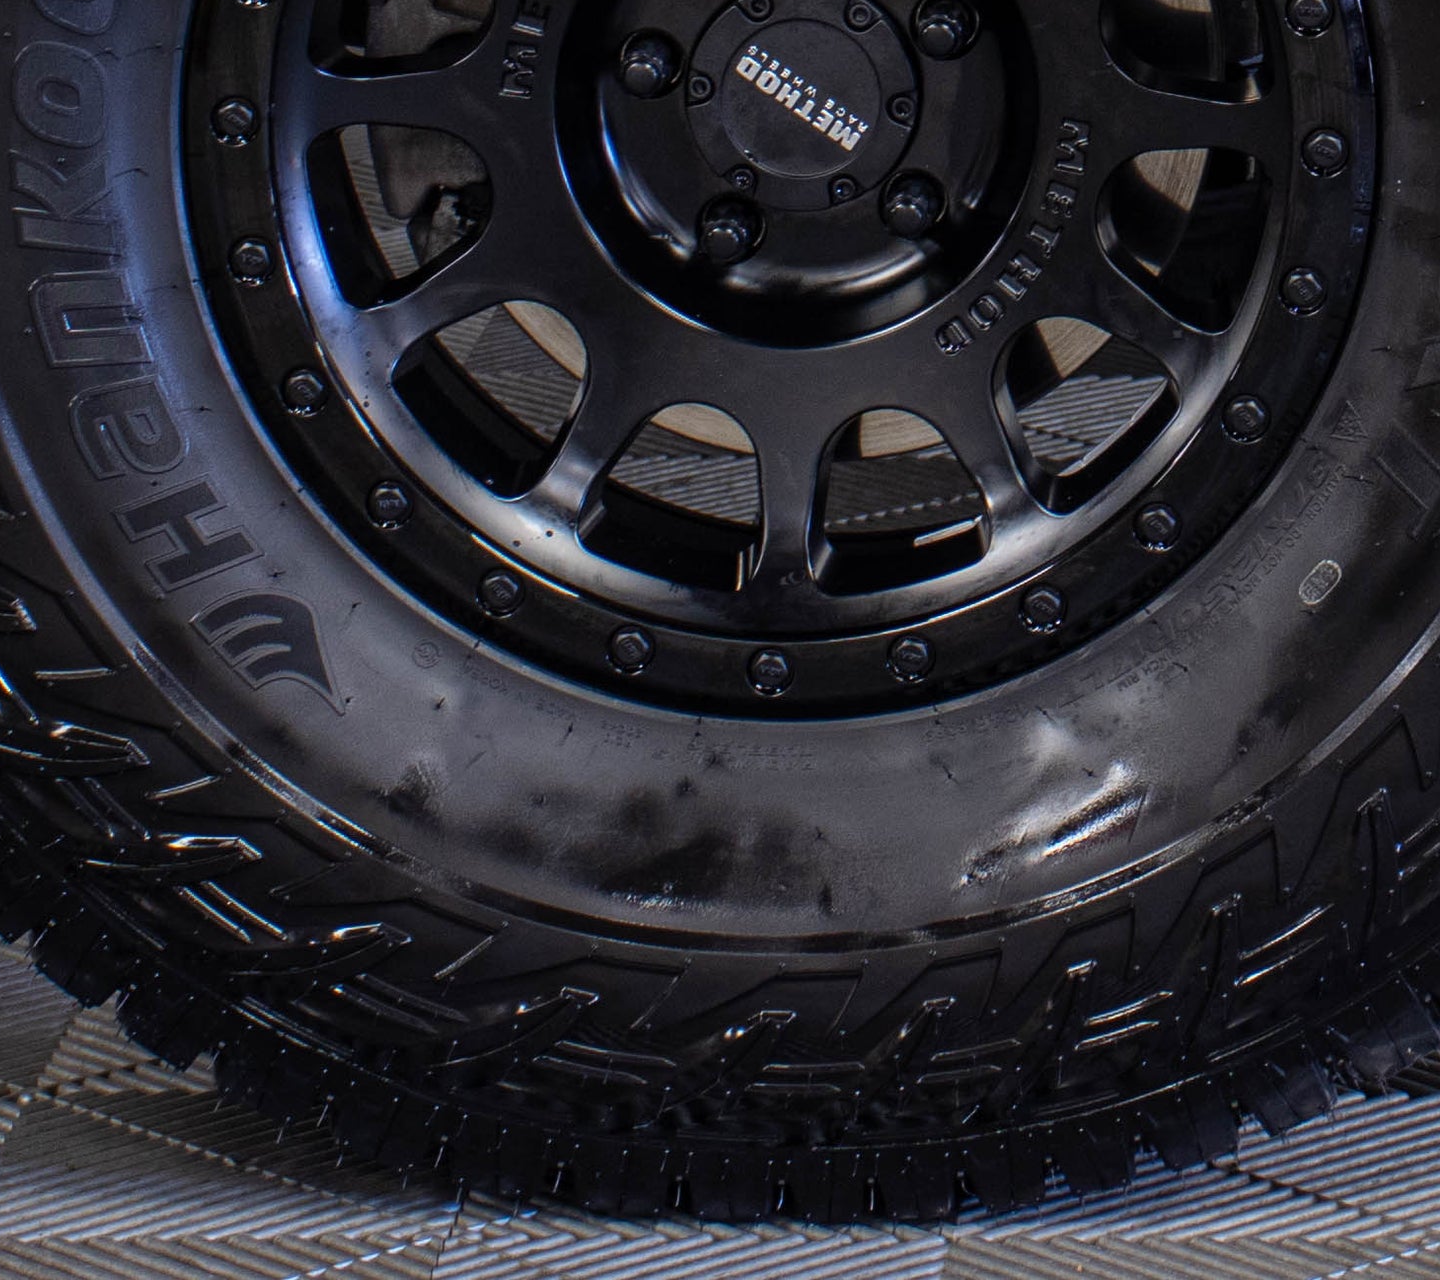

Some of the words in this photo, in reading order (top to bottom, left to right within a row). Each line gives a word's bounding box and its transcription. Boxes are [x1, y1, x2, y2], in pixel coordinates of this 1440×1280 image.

[736, 55, 862, 152] METHOD
[747, 45, 817, 98] WHEELS
[824, 98, 869, 133] RACE
[933, 116, 1091, 357] METHOD
